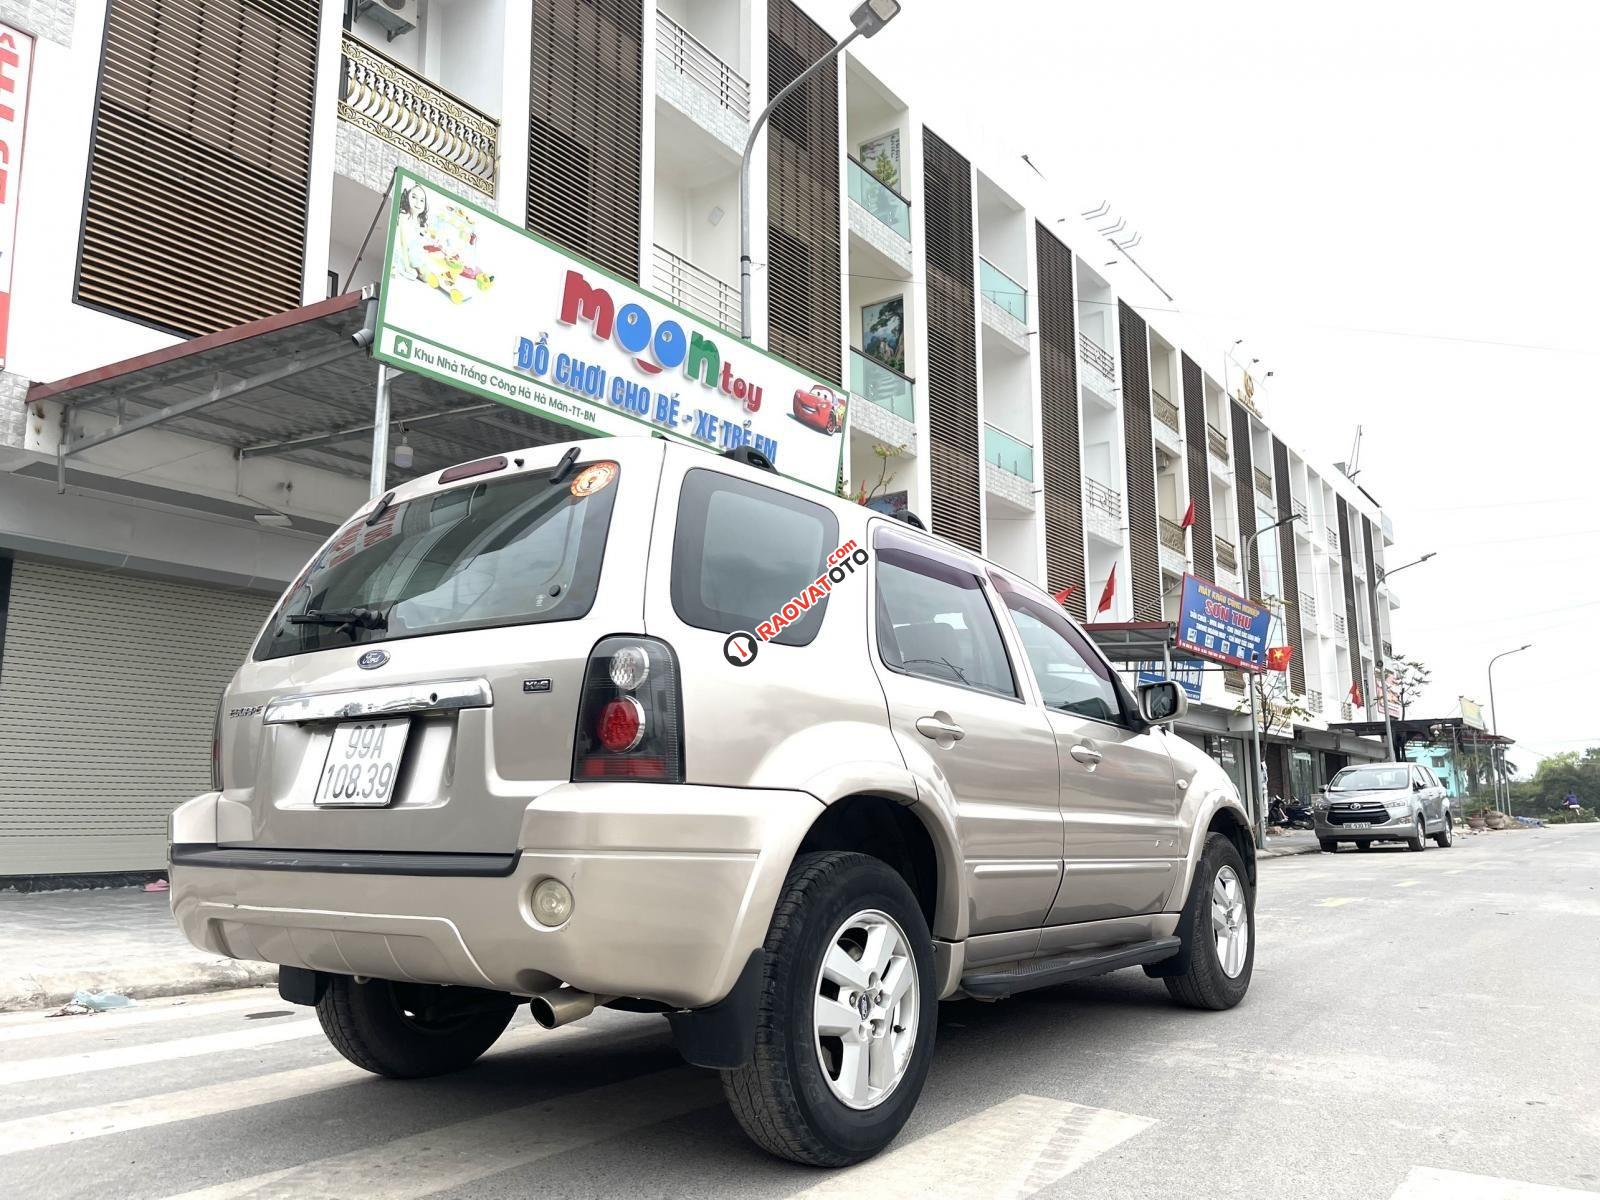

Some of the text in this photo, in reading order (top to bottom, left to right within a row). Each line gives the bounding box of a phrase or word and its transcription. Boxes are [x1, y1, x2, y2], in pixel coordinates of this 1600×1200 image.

[414, 347, 434, 364] Khu
[437, 355, 458, 372] Nhà
[460, 363, 487, 384] Trắng
[490, 376, 517, 395] Công
[518, 386, 531, 399] Hà
[534, 391, 546, 405] Hà
[515, 332, 549, 376] ĐỒ
[554, 353, 607, 399] CHƠI
[610, 376, 651, 415] CHO
[655, 393, 680, 427] BÉ
[694, 409, 719, 442] XE
[345, 723, 388, 760] 99A
[323, 762, 393, 799] 108.39
